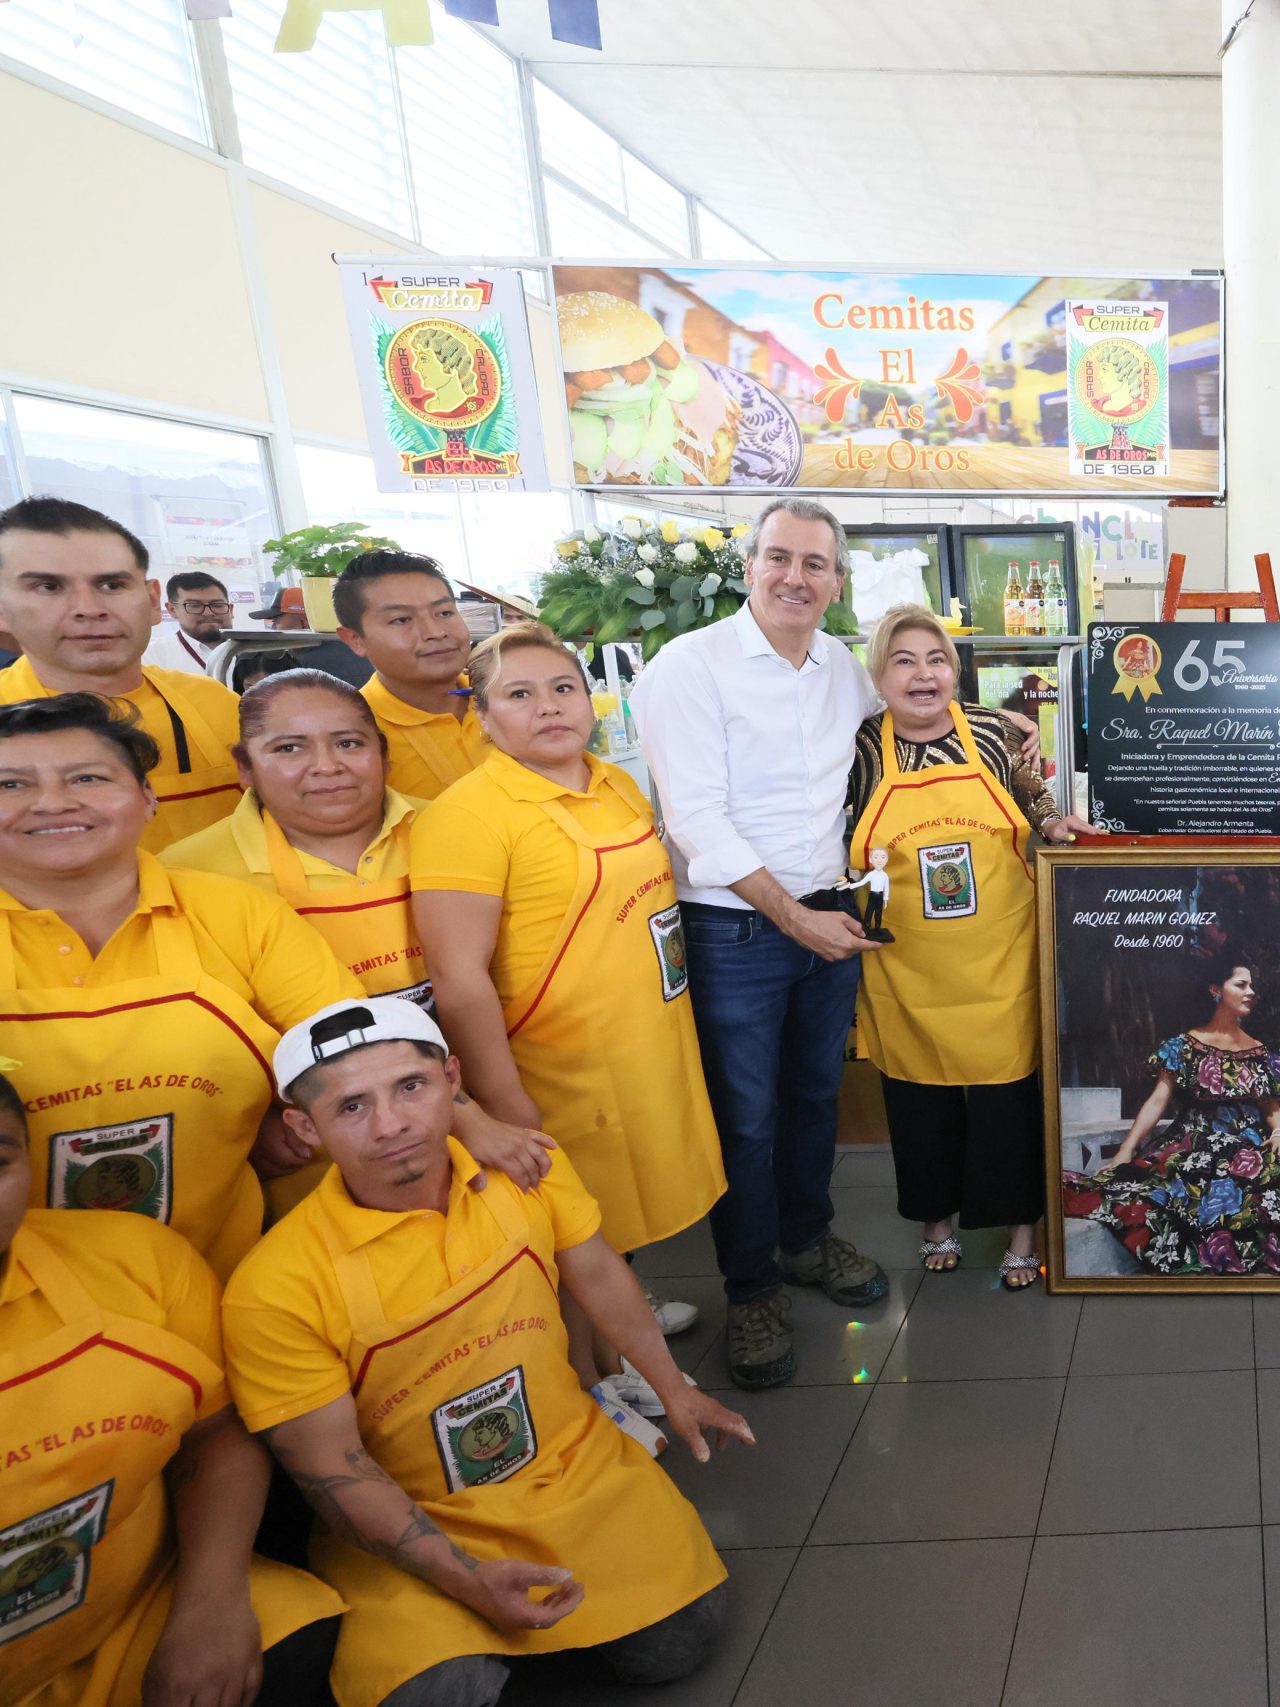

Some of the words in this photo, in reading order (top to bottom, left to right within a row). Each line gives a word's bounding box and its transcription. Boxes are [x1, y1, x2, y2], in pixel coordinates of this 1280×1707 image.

[401, 276, 460, 288] SUPER
[392, 289, 480, 311] Cemita
[813, 293, 975, 332] Cemitas
[1096, 305, 1140, 315] SUPER
[1088, 316, 1150, 333] Cemita
[401, 347, 415, 396] SABOR
[474, 348, 489, 397] CALIDAD
[879, 349, 915, 385] El
[1086, 360, 1094, 398] SABOR
[876, 393, 925, 430] As
[834, 438, 874, 472] de
[886, 440, 970, 472] Oros
[1096, 450, 1108, 461] AS
[1110, 450, 1121, 461] DE
[1123, 450, 1147, 461] OROS
[424, 461, 443, 475] AS
[443, 461, 461, 474] DE
[462, 460, 496, 474] OROS
[1084, 465, 1106, 476] DE
[1111, 465, 1155, 476] 1960
[412, 479, 443, 493] DE
[449, 479, 509, 492] 1960
[1173, 639, 1246, 692] 65
[1221, 668, 1279, 684] Aniversario
[1023, 691, 1028, 700] y
[1029, 689, 1037, 698] la
[1038, 690, 1058, 698] noche
[1101, 717, 1143, 740] Sra.
[1148, 718, 1212, 745] Raquel
[1213, 718, 1274, 741] Marín
[1121, 752, 1159, 760] Iniciadora
[1167, 753, 1225, 761] Emprendedora
[1249, 765, 1274, 773] quienes
[909, 818, 941, 836] CEMITAS
[956, 817, 966, 826] AS
[968, 820, 978, 828] DE
[1189, 820, 1222, 828] Alejandro
[617, 895, 637, 923] SUPER
[637, 874, 662, 897] CEMITAS
[1105, 889, 1181, 903] FUNDADORA
[1073, 912, 1121, 926] RAQUEL
[1124, 912, 1165, 925] MARIN
[1169, 912, 1216, 925] GOMEZ
[1114, 935, 1150, 948] Desde
[1153, 934, 1184, 948] 1960
[348, 952, 398, 975] EMITAS
[24, 1082, 103, 1114] CEMITAS
[107, 1078, 134, 1092] "EL
[140, 1075, 162, 1088] AS
[166, 1075, 189, 1087] DE
[97, 1128, 135, 1140] SUPER
[372, 1388, 411, 1423] SUPER
[414, 1344, 471, 1386] CEMITAS
[494, 1327, 509, 1339] AS
[512, 1319, 526, 1332] DE
[457, 1387, 508, 1416] CEMITAS
[467, 1385, 497, 1403] SUPER
[71, 1421, 95, 1443] AS
[101, 1415, 126, 1434] DE
